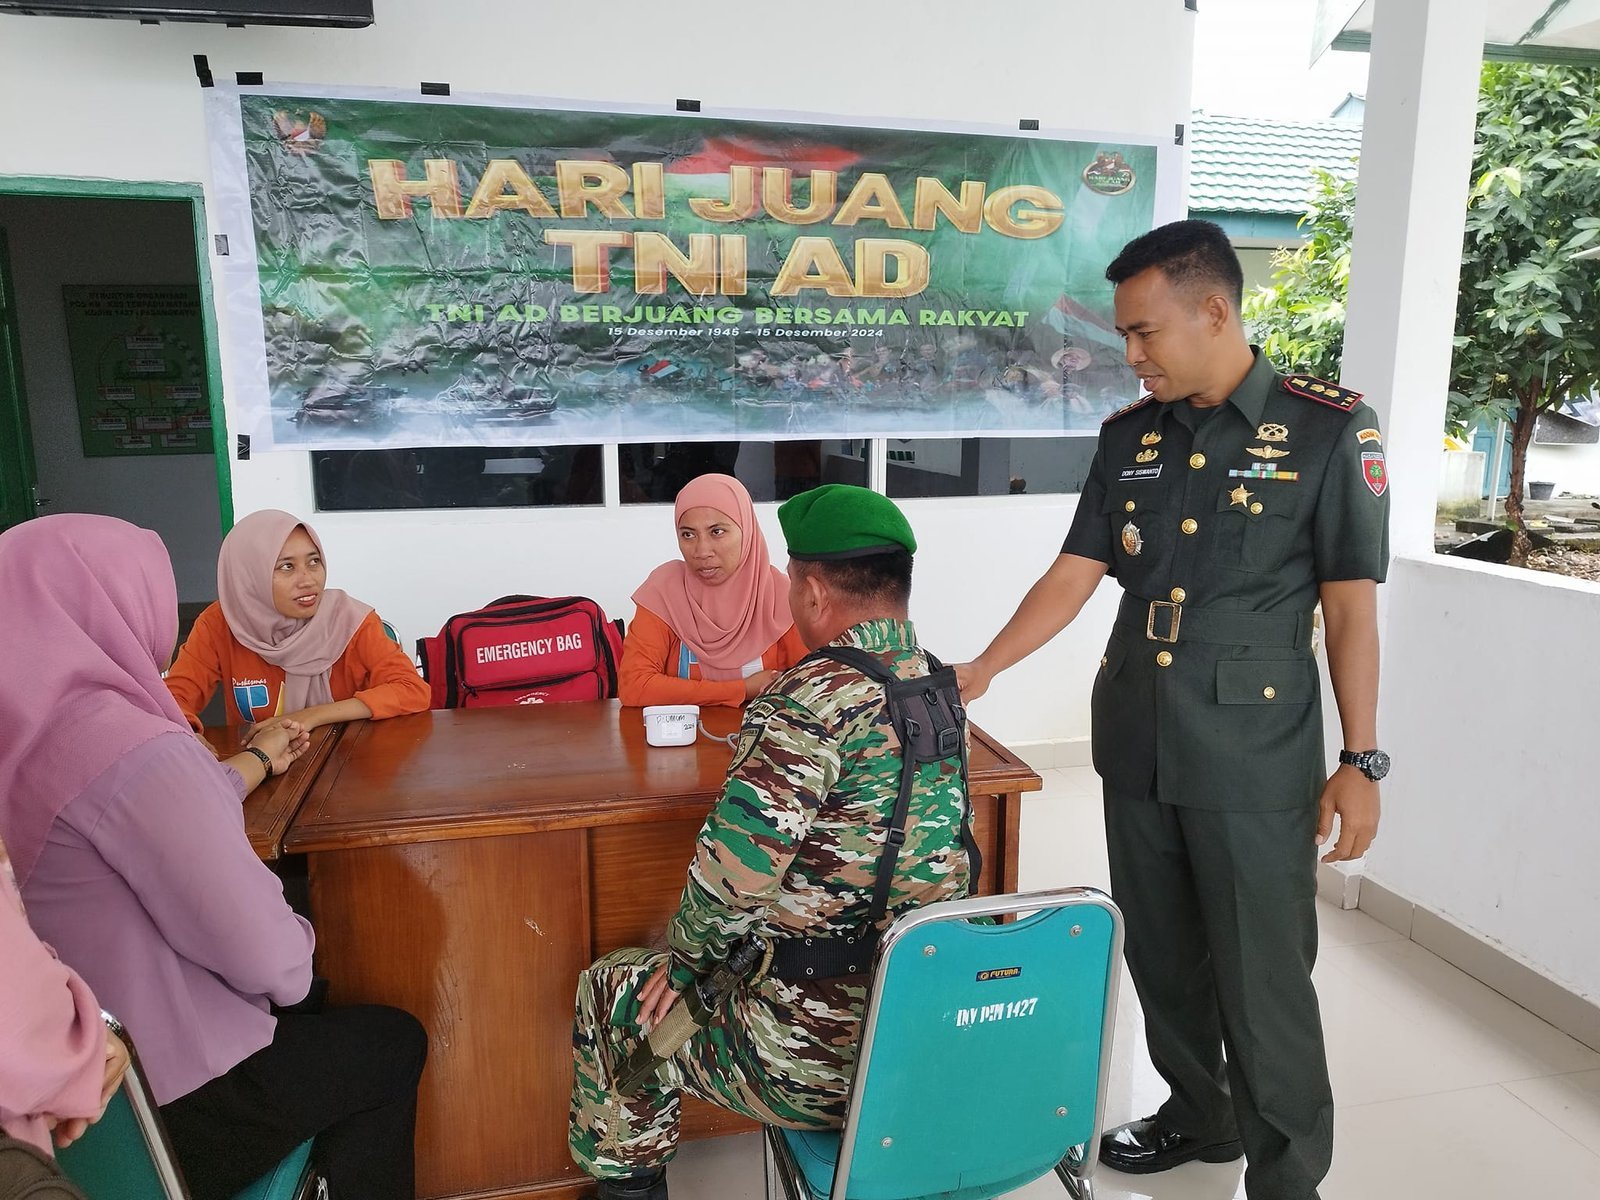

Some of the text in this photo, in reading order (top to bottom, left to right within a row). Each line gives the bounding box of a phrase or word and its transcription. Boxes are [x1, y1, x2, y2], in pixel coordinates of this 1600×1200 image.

[368, 159, 1065, 240] HARI JUANG
[544, 229, 930, 298] TNI AD
[425, 304, 1030, 328] TNI AD BERJUANG BERSAMA RAKYAT
[608, 327, 623, 336] 15
[627, 327, 704, 336] Desember
[708, 327, 740, 336] 1945
[757, 328, 771, 336] 15
[775, 328, 848, 337] Desember
[851, 329, 883, 337] 2024
[476, 633, 582, 664] EMERGENCY BAG
[990, 968, 1019, 978] FUTURA
[1006, 997, 1038, 1018] 1427
